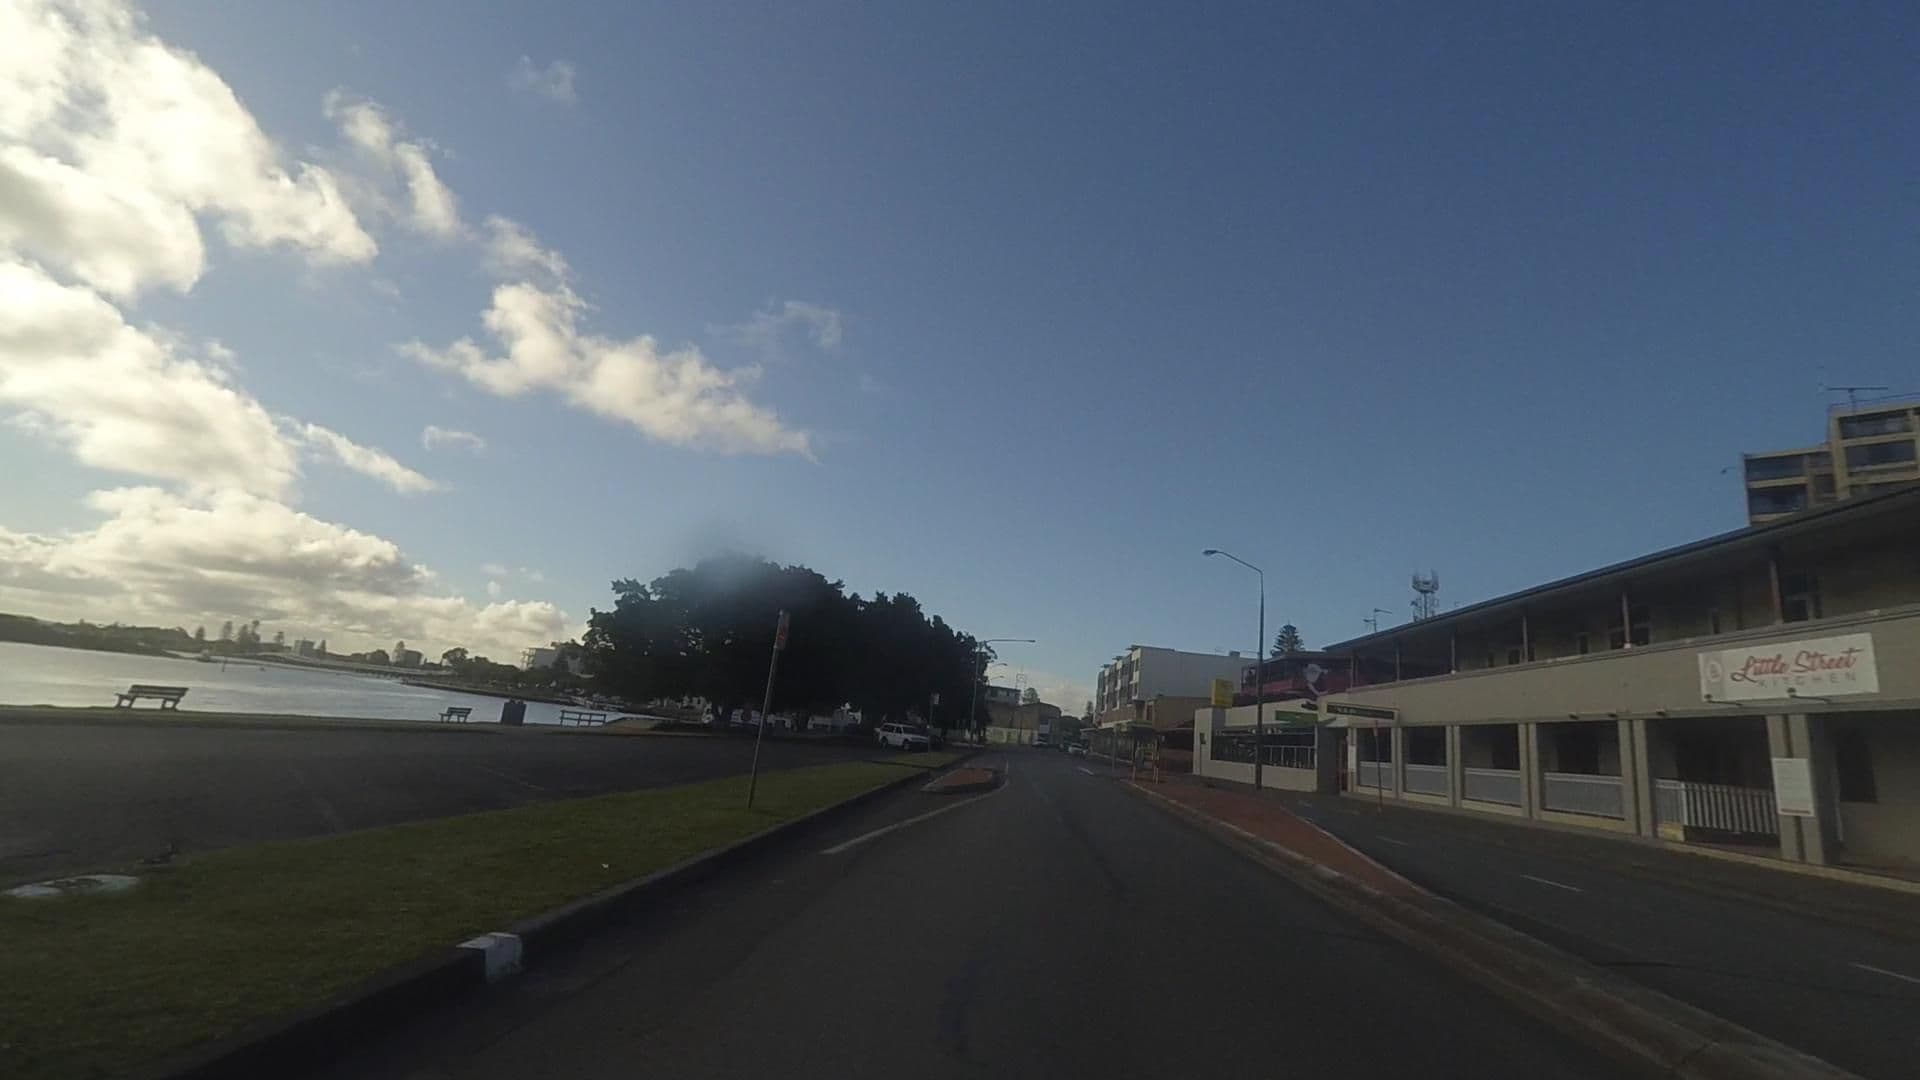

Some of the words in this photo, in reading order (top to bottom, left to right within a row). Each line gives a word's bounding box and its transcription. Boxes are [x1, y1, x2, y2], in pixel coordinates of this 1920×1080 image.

[1730, 654, 1789, 683] Little
[1791, 647, 1864, 673] Street
[1759, 672, 1857, 688] KITCHEN
